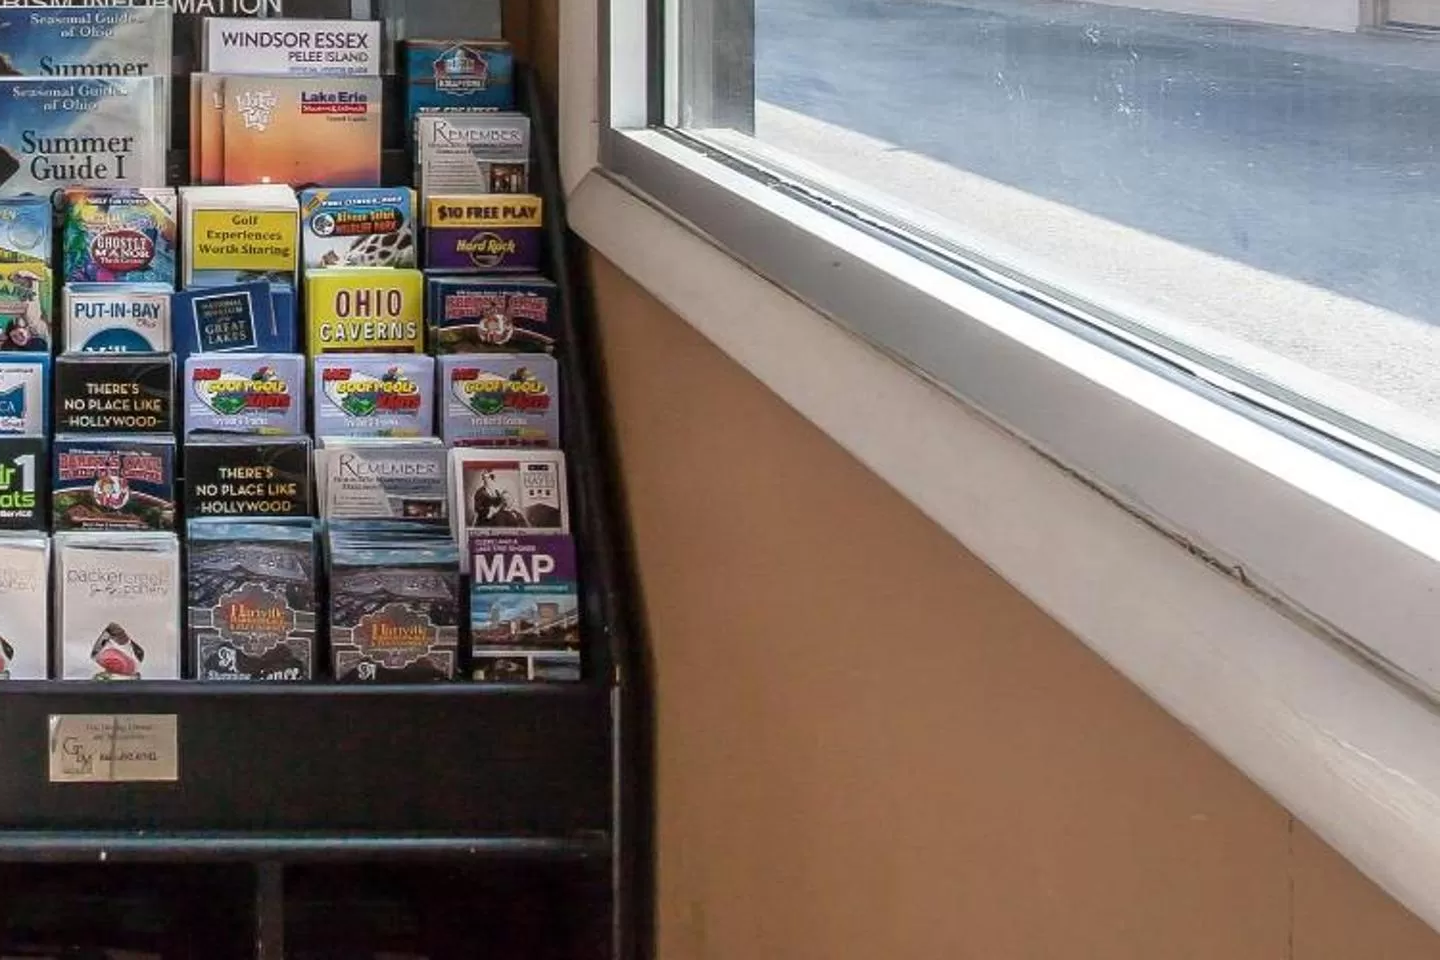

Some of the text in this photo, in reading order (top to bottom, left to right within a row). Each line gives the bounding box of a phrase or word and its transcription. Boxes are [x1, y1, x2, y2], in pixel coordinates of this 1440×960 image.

[30, 13, 92, 25] Seasonal
[60, 26, 114, 38] of Ohio
[221, 31, 369, 49] WINDSOR ESSEX
[288, 52, 369, 62] PELEE ISLAND
[39, 56, 148, 76] Summer
[12, 87, 74, 99] Seasonal
[301, 92, 368, 103] Lake Erie
[43, 100, 58, 112] of
[433, 120, 521, 146] REMEMBER
[21, 130, 134, 155] Summer
[30, 155, 126, 181] Guide I
[437, 205, 538, 221] $10 FREE PLAY
[231, 215, 259, 226] Golf
[97, 236, 148, 250] GHOSTLY
[206, 230, 283, 243] Experiences
[199, 244, 290, 257] Worth Sharing
[456, 239, 516, 254] Hard Rock
[94, 249, 150, 259] MANOR
[335, 289, 402, 318] OHIO
[74, 303, 160, 319] PUT-IN-BAY
[204, 320, 246, 335] GREAT
[319, 322, 417, 341] CAVERNS
[86, 383, 140, 395] THERE'S
[64, 398, 162, 411] NO PLACE LIKE
[68, 415, 159, 428] HOLLYWOOD
[13, 454, 36, 492] 1
[338, 454, 437, 478] REMEMBER
[218, 467, 274, 480] THERE'S
[195, 482, 298, 497] NO PLACE LIKE
[200, 501, 292, 514] HOLLYWOOD
[474, 554, 555, 583] MAP
[67, 568, 123, 584] packer
